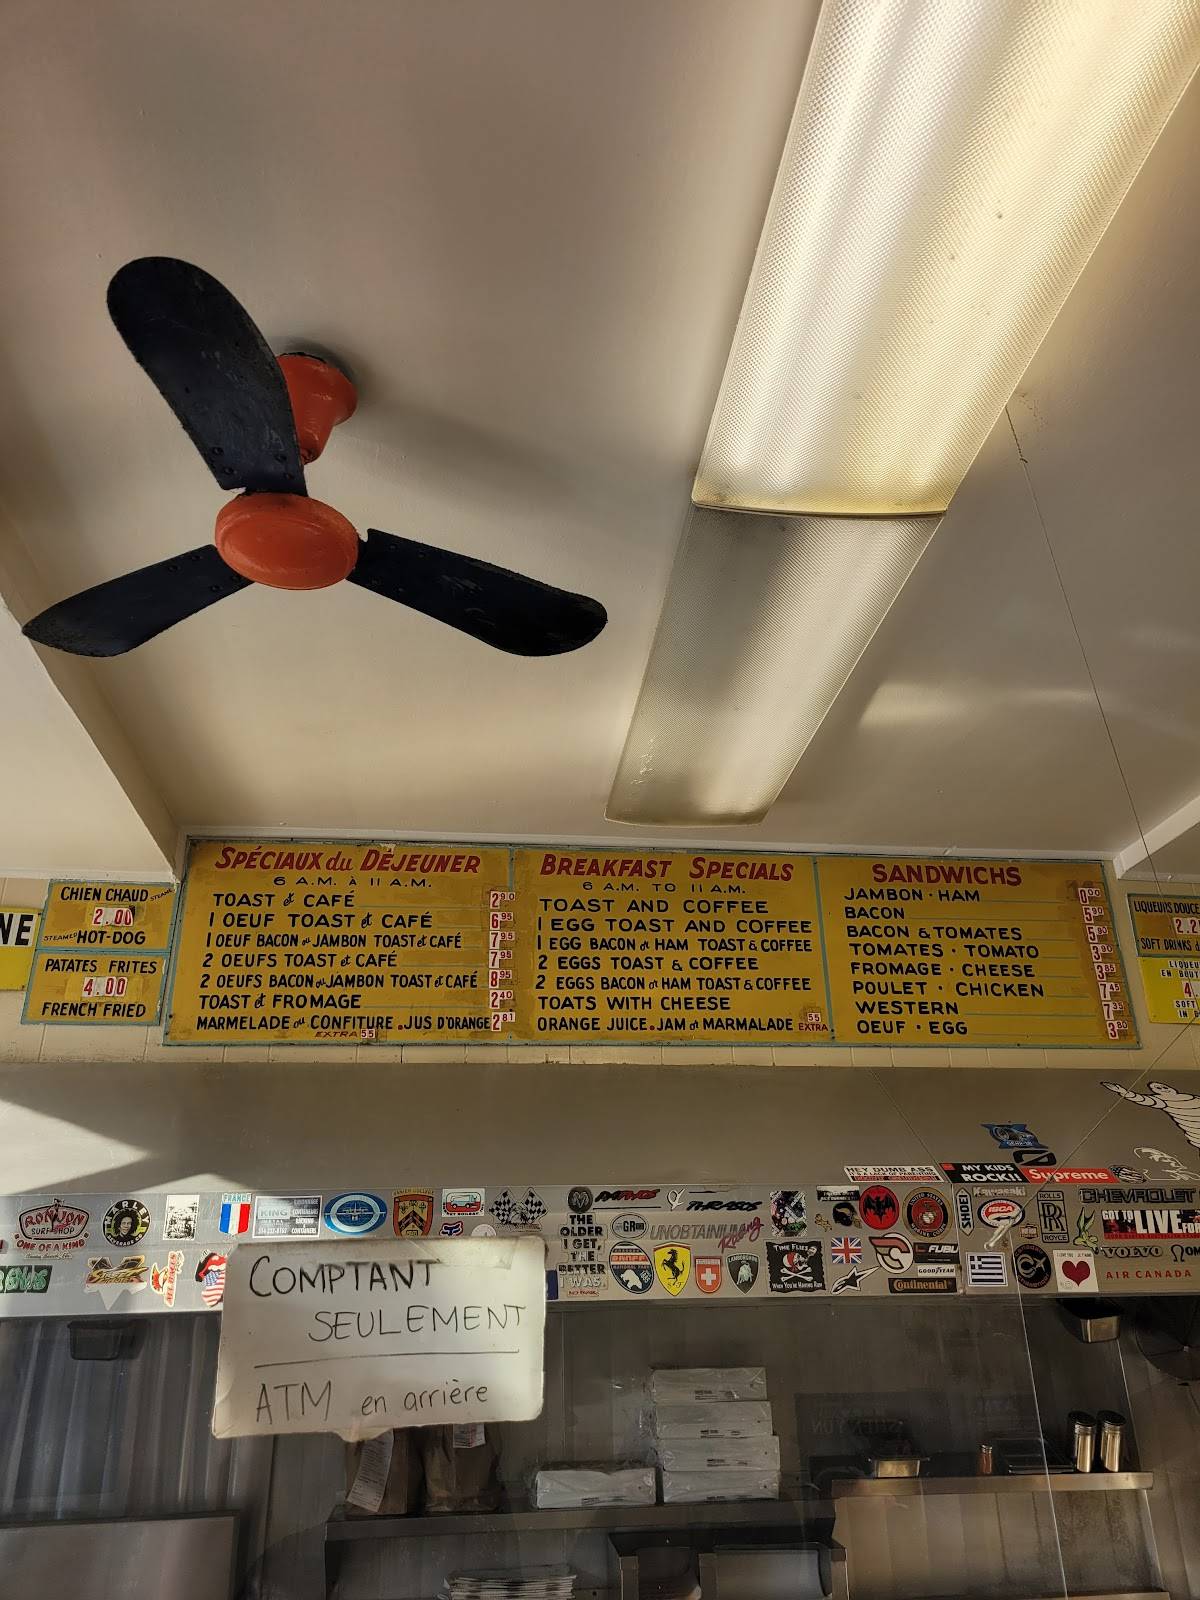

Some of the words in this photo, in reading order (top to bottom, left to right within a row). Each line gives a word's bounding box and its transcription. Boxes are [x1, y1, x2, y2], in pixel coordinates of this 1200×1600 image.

[215, 846, 323, 871] SPÉCIAUX
[326, 851, 353, 872] du
[360, 847, 480, 873] DÉJEUNER
[540, 853, 672, 878] BREAKFAST
[689, 856, 794, 881] SPECIALS
[274, 876, 286, 886] 6
[296, 877, 337, 886] A.M.
[390, 878, 432, 887] A.M.
[872, 864, 1022, 886] SANDWICHS
[60, 886, 101, 901] CHIEN
[105, 888, 148, 902] CHAUD
[583, 881, 593, 891] 6
[603, 882, 640, 891] A.M.
[652, 883, 676, 892] TO
[711, 884, 746, 894] A.M.
[844, 888, 923, 901] JAMBON
[938, 889, 980, 902] HAM
[213, 893, 275, 907] TOAST
[283, 892, 294, 907] et
[304, 890, 354, 907] CAFÉ
[540, 898, 615, 913] TOAST
[627, 899, 669, 913] AND
[683, 900, 768, 914] COFFEE
[845, 906, 905, 920] BACON
[1134, 901, 1173, 914] LIQUEURS
[92, 908, 133, 926] 2.00
[209, 912, 215, 928] 1
[223, 913, 275, 928] OEUF
[288, 913, 355, 928] TOAST
[361, 912, 372, 928] et
[382, 911, 433, 929] CAFÉ
[551, 918, 595, 932] EGG
[605, 918, 674, 932] TOAST
[685, 919, 725, 933] AND
[737, 919, 812, 934] COFFEE
[847, 925, 910, 938] BACON
[918, 927, 931, 939] &
[933, 926, 1022, 941] TOMATES
[76, 931, 146, 945] HOT-DOG
[206, 932, 211, 948] 1
[216, 933, 251, 948] OEUF
[256, 933, 299, 948] BACON
[312, 934, 366, 948] JAMBON
[374, 934, 416, 949] TOAST
[429, 932, 462, 949] CAFÉ
[550, 937, 582, 950] EGG
[590, 937, 635, 951] BACON
[655, 938, 688, 951] HAM
[698, 938, 745, 951] TOAST
[749, 941, 757, 951] &
[761, 939, 812, 952] COFFEE
[1140, 938, 1161, 950] SOFT
[1164, 938, 1191, 951] DRINKS
[849, 943, 944, 957] TOMATES
[964, 944, 1039, 958] TOMATO
[45, 959, 97, 973] PATATES
[108, 960, 157, 974] FRITES
[202, 953, 213, 968] 2
[221, 953, 277, 968] OEUFS
[285, 953, 337, 968] TOAST
[340, 954, 352, 968] et
[356, 950, 397, 968] CAFÉ
[538, 954, 548, 970] 2
[558, 956, 600, 970] EGGS
[610, 956, 664, 970] TOAST
[671, 959, 683, 971] &
[689, 956, 759, 970] COFFEE
[850, 962, 942, 976] FROMAGE
[962, 963, 1035, 977] CHEESE
[83, 977, 127, 996] 4.00
[200, 973, 211, 989] 2
[217, 974, 262, 988] OEUFS
[269, 974, 314, 988] BACON
[326, 974, 384, 988] JAMBON
[391, 974, 432, 988] TOAST
[445, 971, 477, 989] CAFÉ
[536, 974, 546, 990] 2
[556, 976, 595, 990] EGGS
[601, 976, 645, 990] BACON
[661, 977, 691, 990] HAM
[696, 977, 741, 990] TOAST
[743, 979, 753, 990] &
[756, 977, 811, 991] COFFEE
[853, 980, 927, 995] POULET
[956, 982, 1044, 997] CHICKEN
[199, 994, 251, 1010] TOAST
[254, 992, 266, 1009] et
[272, 994, 361, 1009] FROMAGE
[538, 996, 597, 1010] TOATS
[606, 996, 652, 1010] WITH
[660, 996, 731, 1010] CHEESE
[855, 1001, 959, 1015] WESTERN
[42, 1002, 97, 1017] FRENCH
[103, 1003, 146, 1017] FRIED
[197, 1015, 290, 1030] MARMELADE
[311, 1015, 393, 1030] CONFITURE
[404, 1015, 432, 1030] JUS
[437, 1015, 490, 1030] D'ORANGE
[537, 1017, 600, 1031] ORANGE
[607, 1017, 647, 1031] JUICE
[656, 1017, 686, 1031] JAM
[703, 1017, 793, 1031] MARMALADE
[798, 1022, 828, 1032] EXTRA
[857, 1020, 905, 1034] OEUF
[929, 1021, 968, 1035] EGG
[315, 1030, 358, 1038] EXTRA
[962, 1164, 981, 1172] MY
[986, 1164, 1014, 1172] KIDS
[1029, 1168, 1109, 1183] Supreme
[960, 1173, 1021, 1182] ROCK!!
[1079, 1187, 1197, 1204] CHEVROLET
[105, 1200, 150, 1227] MARLEY
[569, 1214, 593, 1224] THE
[959, 1194, 972, 1231] SHOEI
[560, 1226, 603, 1237] OLDER
[570, 1250, 595, 1261] THE
[1101, 1246, 1163, 1258] VOLVO
[249, 1255, 441, 1297] COMPTANT
[558, 1263, 606, 1275] BETTER
[918, 1266, 955, 1274] GOODYEAR
[1106, 1271, 1129, 1279] AIR
[1135, 1269, 1192, 1278] CANADA
[894, 1279, 948, 1291] Continental
[308, 1304, 527, 1342] SEULEMENT
[256, 1379, 332, 1425] ATM
[361, 1393, 387, 1416] en
[404, 1378, 488, 1412] arrière
